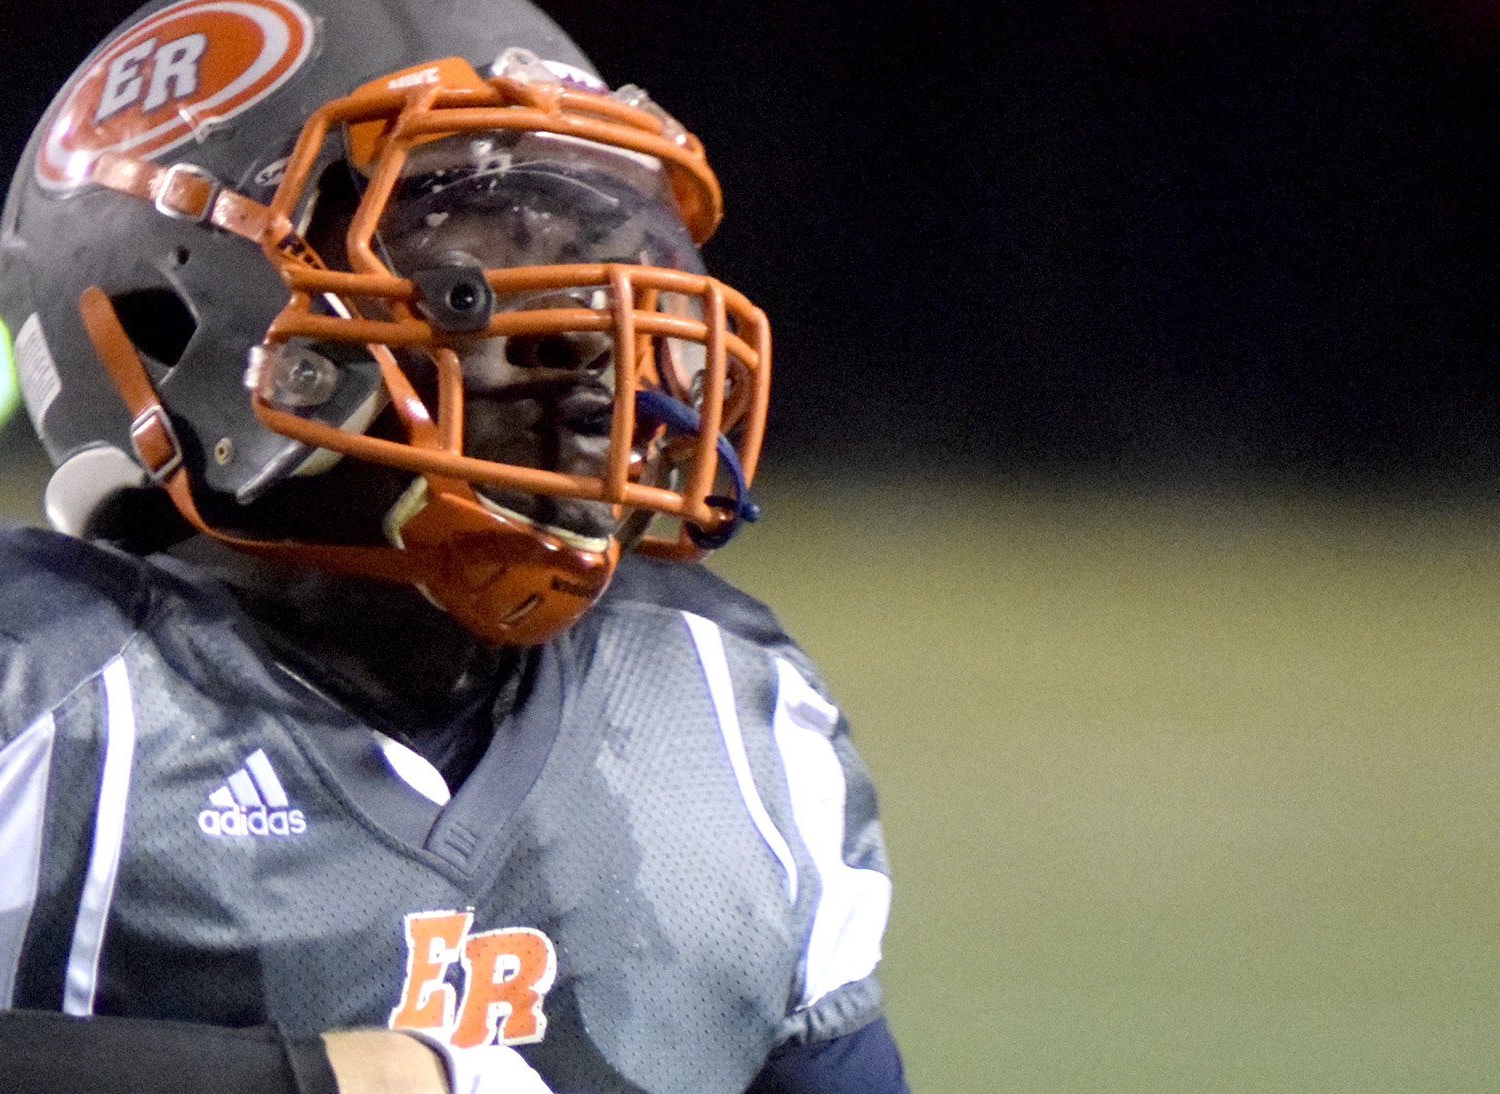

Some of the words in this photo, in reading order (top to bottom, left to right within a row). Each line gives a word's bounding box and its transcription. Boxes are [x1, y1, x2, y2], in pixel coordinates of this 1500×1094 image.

[94, 32, 207, 122] ER
[198, 803, 307, 836] adidas
[388, 906, 557, 1049] ER
